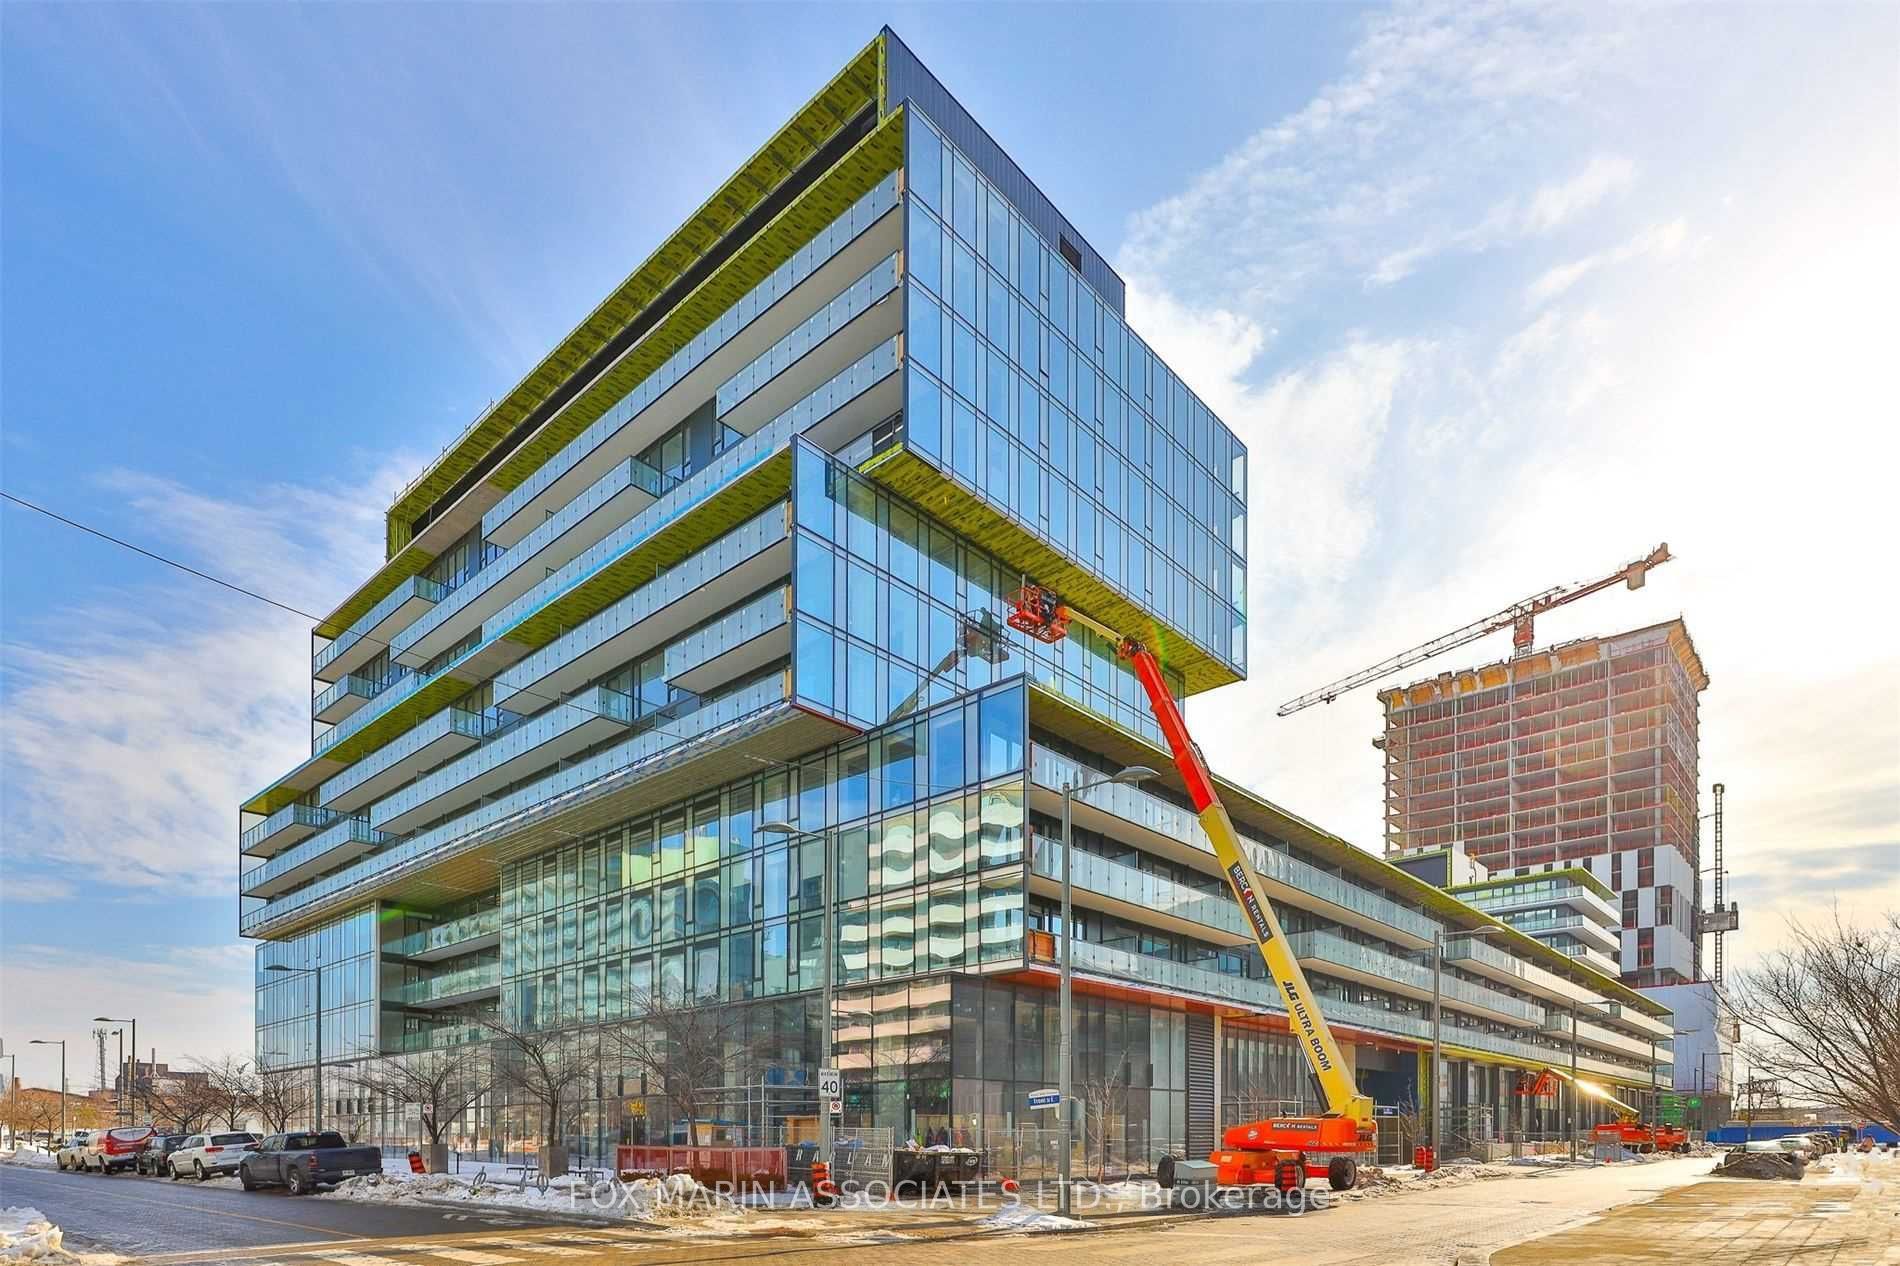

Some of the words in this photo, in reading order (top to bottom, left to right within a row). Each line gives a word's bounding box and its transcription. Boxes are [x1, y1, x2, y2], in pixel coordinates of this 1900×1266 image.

[1251, 904, 1269, 938] RENTALS
[1282, 980, 1299, 1001] JLG
[1294, 1002, 1315, 1037] ULTRA
[1310, 1038, 1332, 1071] BOOM
[821, 1080, 838, 1093] 40
